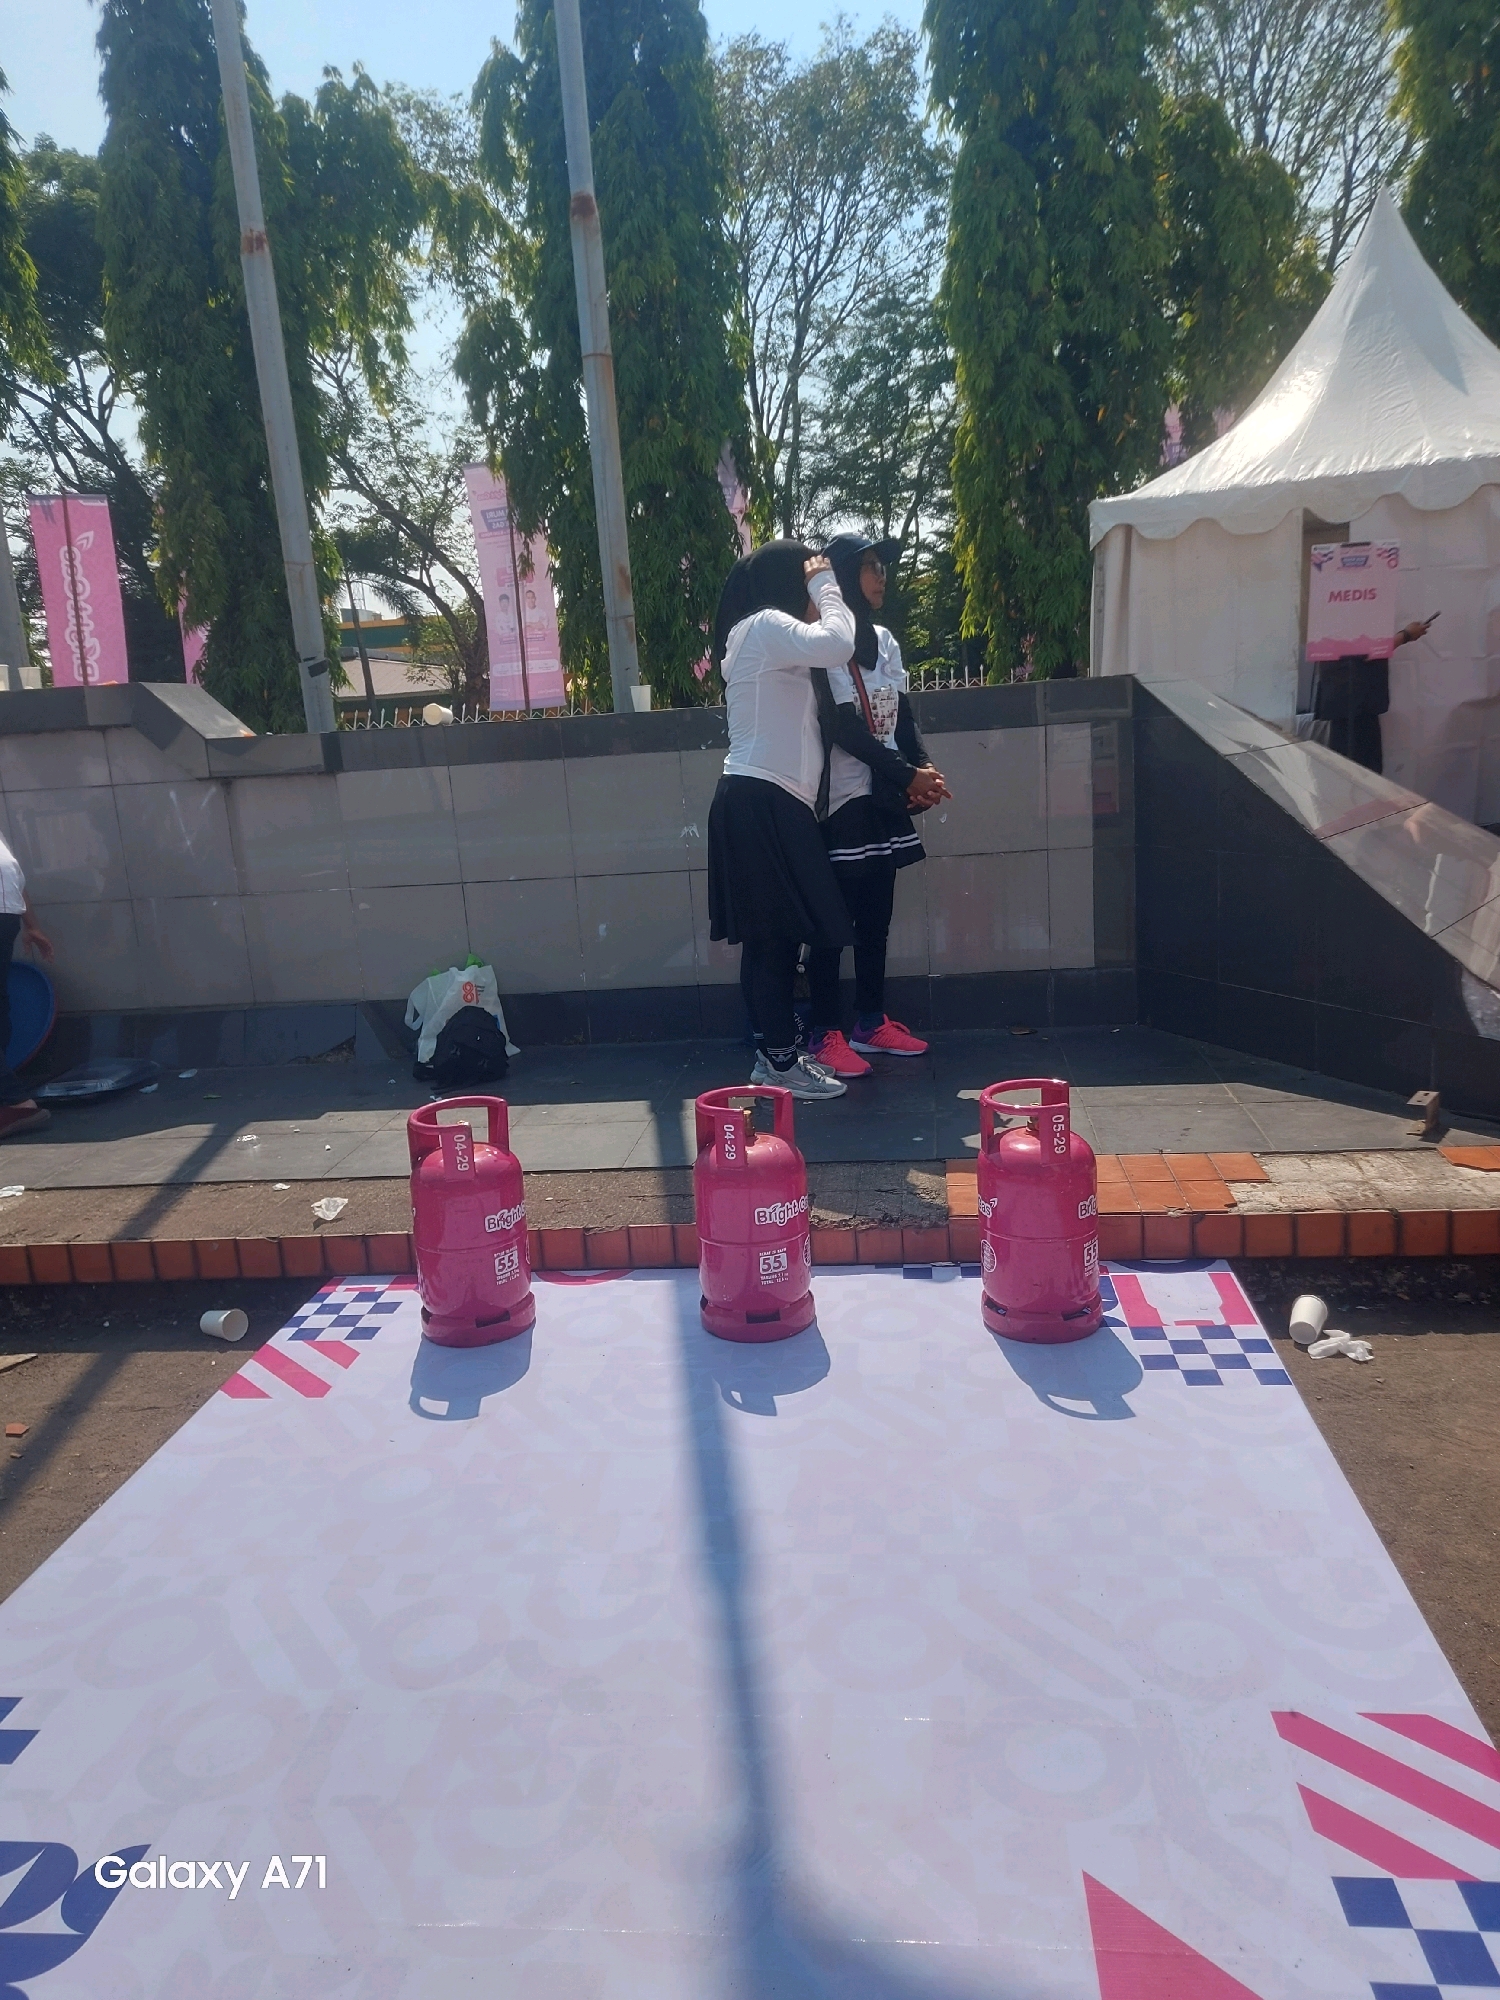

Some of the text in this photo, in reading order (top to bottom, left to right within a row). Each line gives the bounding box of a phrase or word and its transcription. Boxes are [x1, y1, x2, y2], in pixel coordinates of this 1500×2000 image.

[1328, 588, 1377, 603] MEDIS
[724, 1125, 736, 1160] 04-29
[1052, 1115, 1066, 1154] 05-29
[454, 1135, 469, 1171] 04-29
[755, 1201, 798, 1226] Bright
